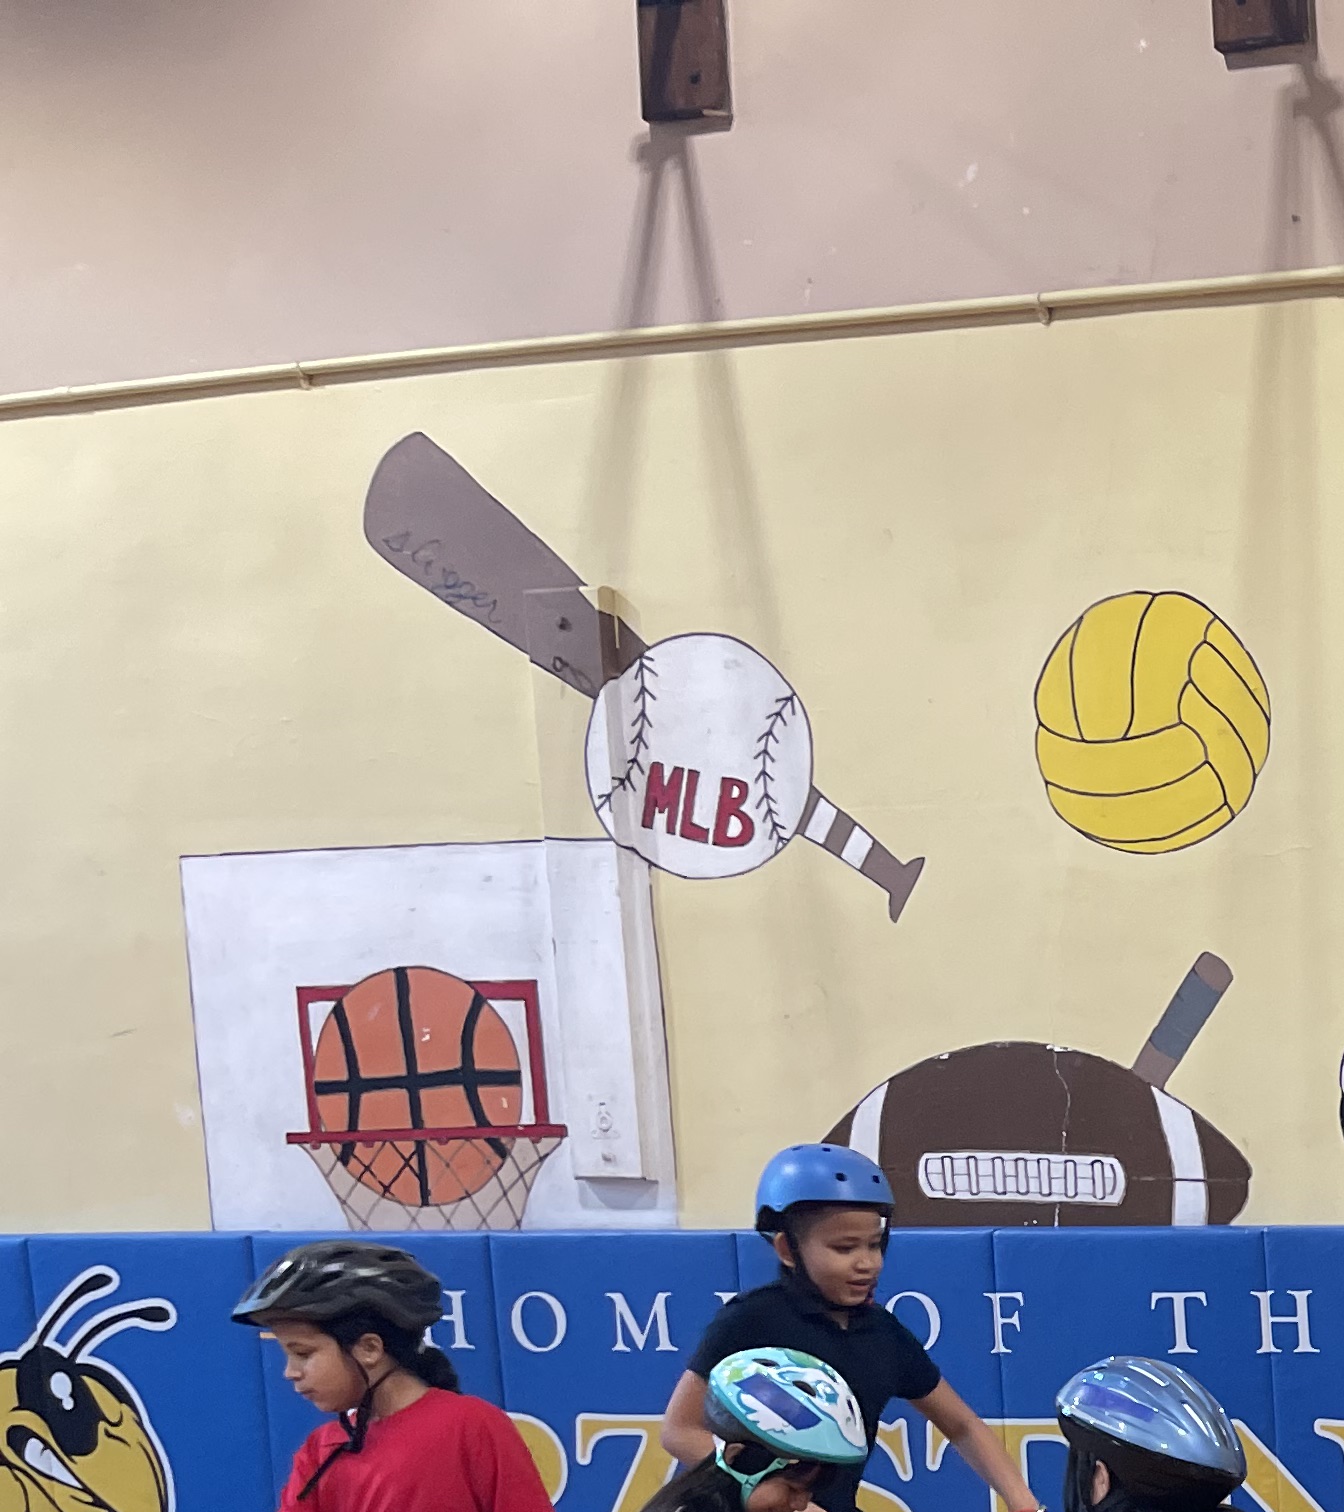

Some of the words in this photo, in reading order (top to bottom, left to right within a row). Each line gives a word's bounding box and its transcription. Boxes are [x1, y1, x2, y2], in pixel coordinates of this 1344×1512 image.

[641, 760, 756, 849] MLB
[423, 1290, 738, 1353] HOM
[888, 1290, 1025, 1355] OF
